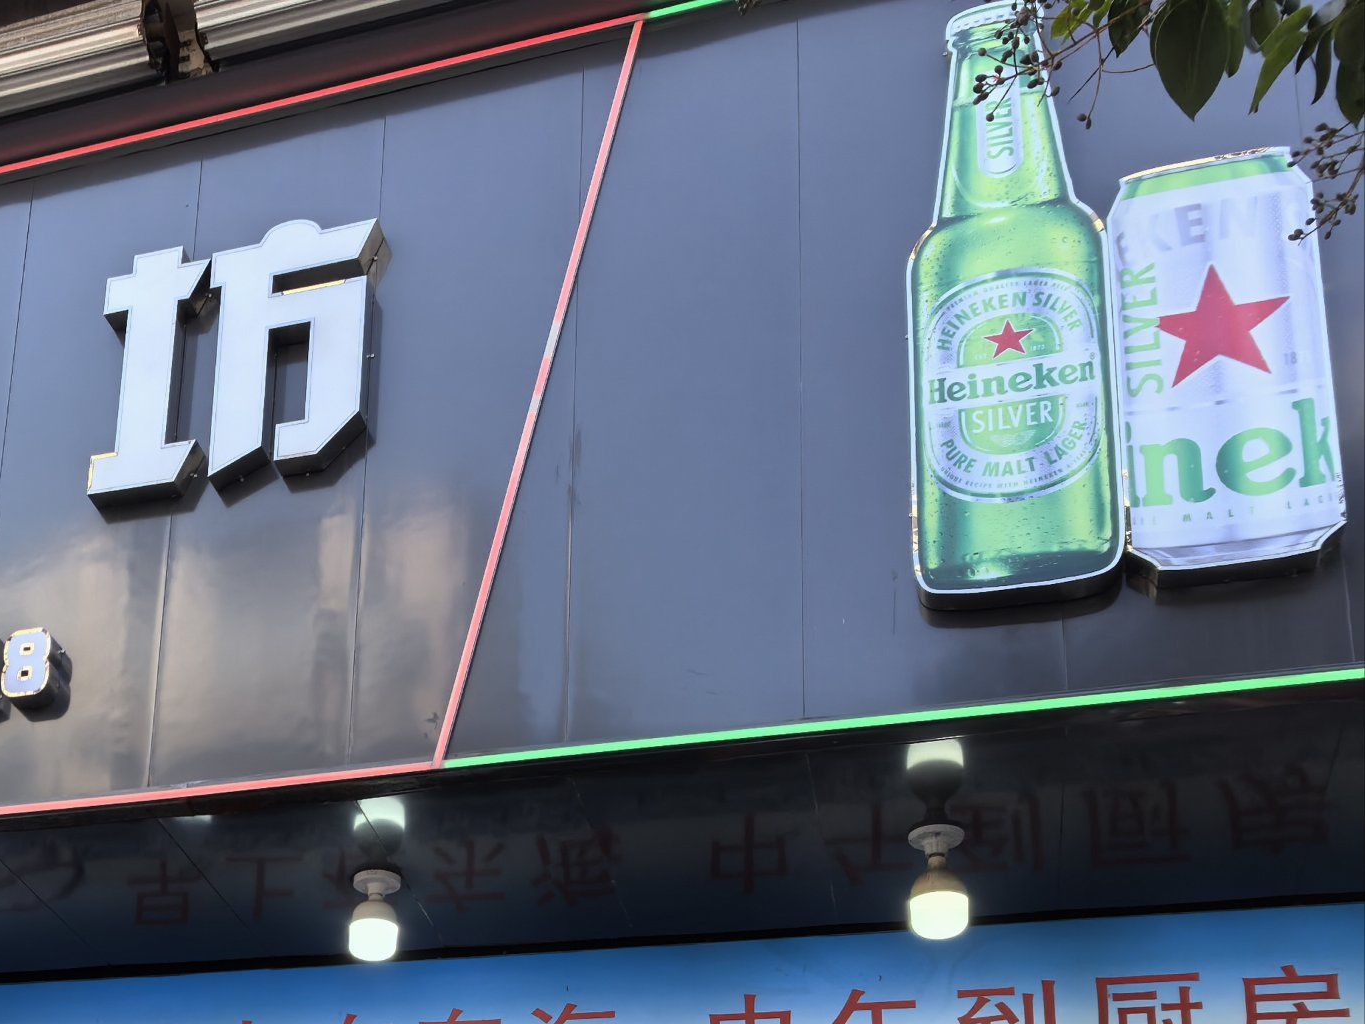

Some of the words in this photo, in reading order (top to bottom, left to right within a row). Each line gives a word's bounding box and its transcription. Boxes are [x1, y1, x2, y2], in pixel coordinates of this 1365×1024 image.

[936, 291, 1028, 351] HEINEKEN
[1032, 291, 1083, 331] SILVER
[1120, 262, 1164, 398] SILVER
[928, 359, 1096, 405] Heineken
[972, 400, 1054, 434] SILVER
[940, 438, 977, 474] PURE
[982, 457, 1036, 477] MALT
[1044, 420, 1087, 465] LAGER
